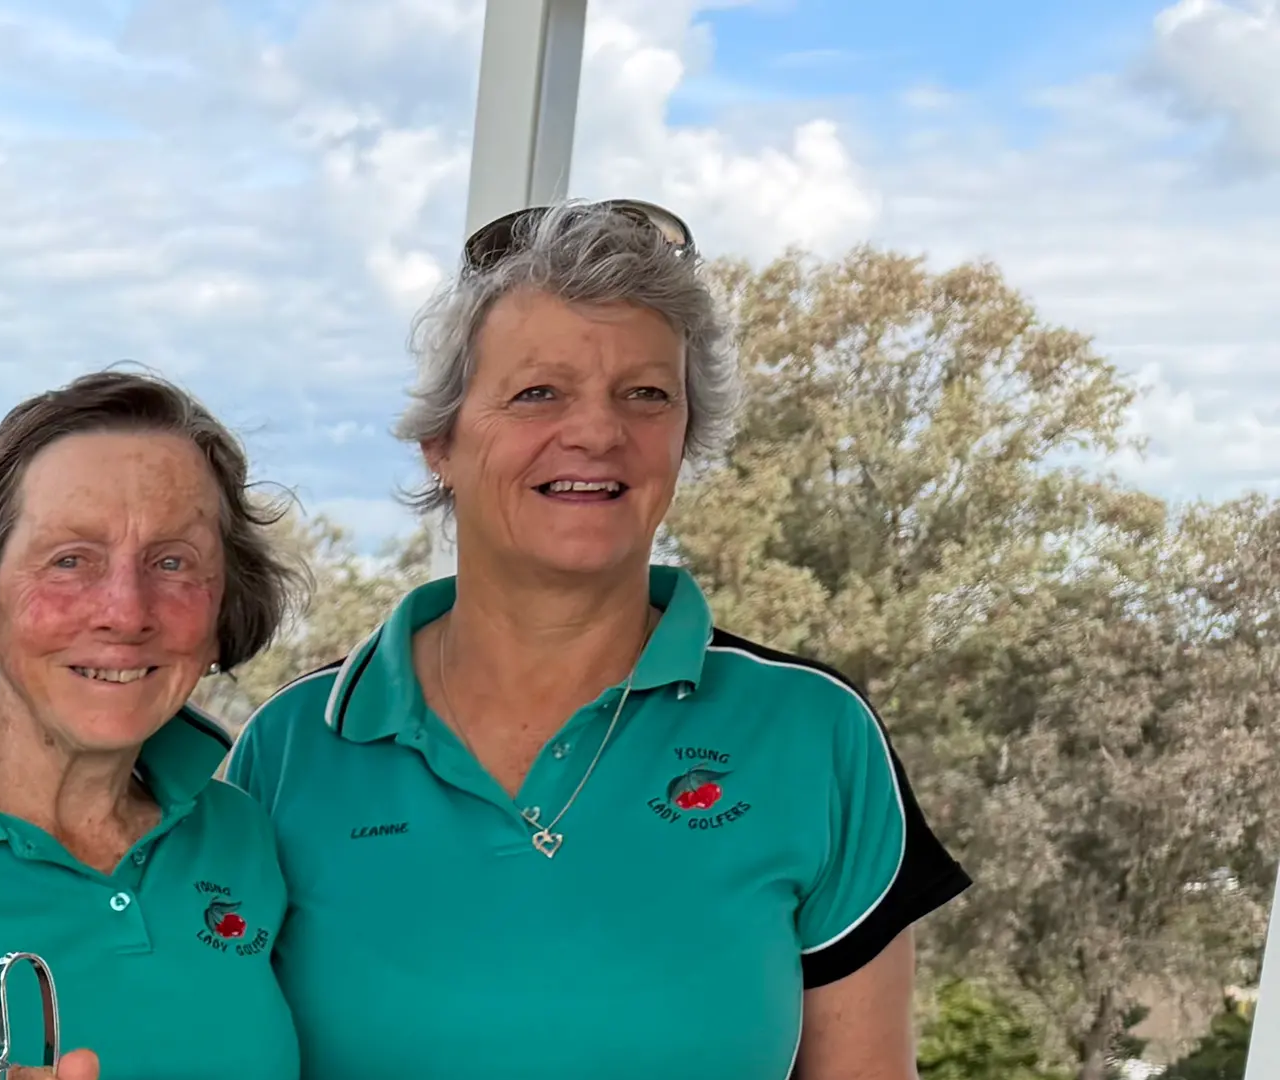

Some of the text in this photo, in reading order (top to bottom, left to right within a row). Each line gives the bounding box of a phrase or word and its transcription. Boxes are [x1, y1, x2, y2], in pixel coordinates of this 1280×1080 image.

[674, 747, 730, 764] YOUNG
[647, 797, 751, 830] LADY GOLFERS
[350, 822, 409, 839] LEANNE
